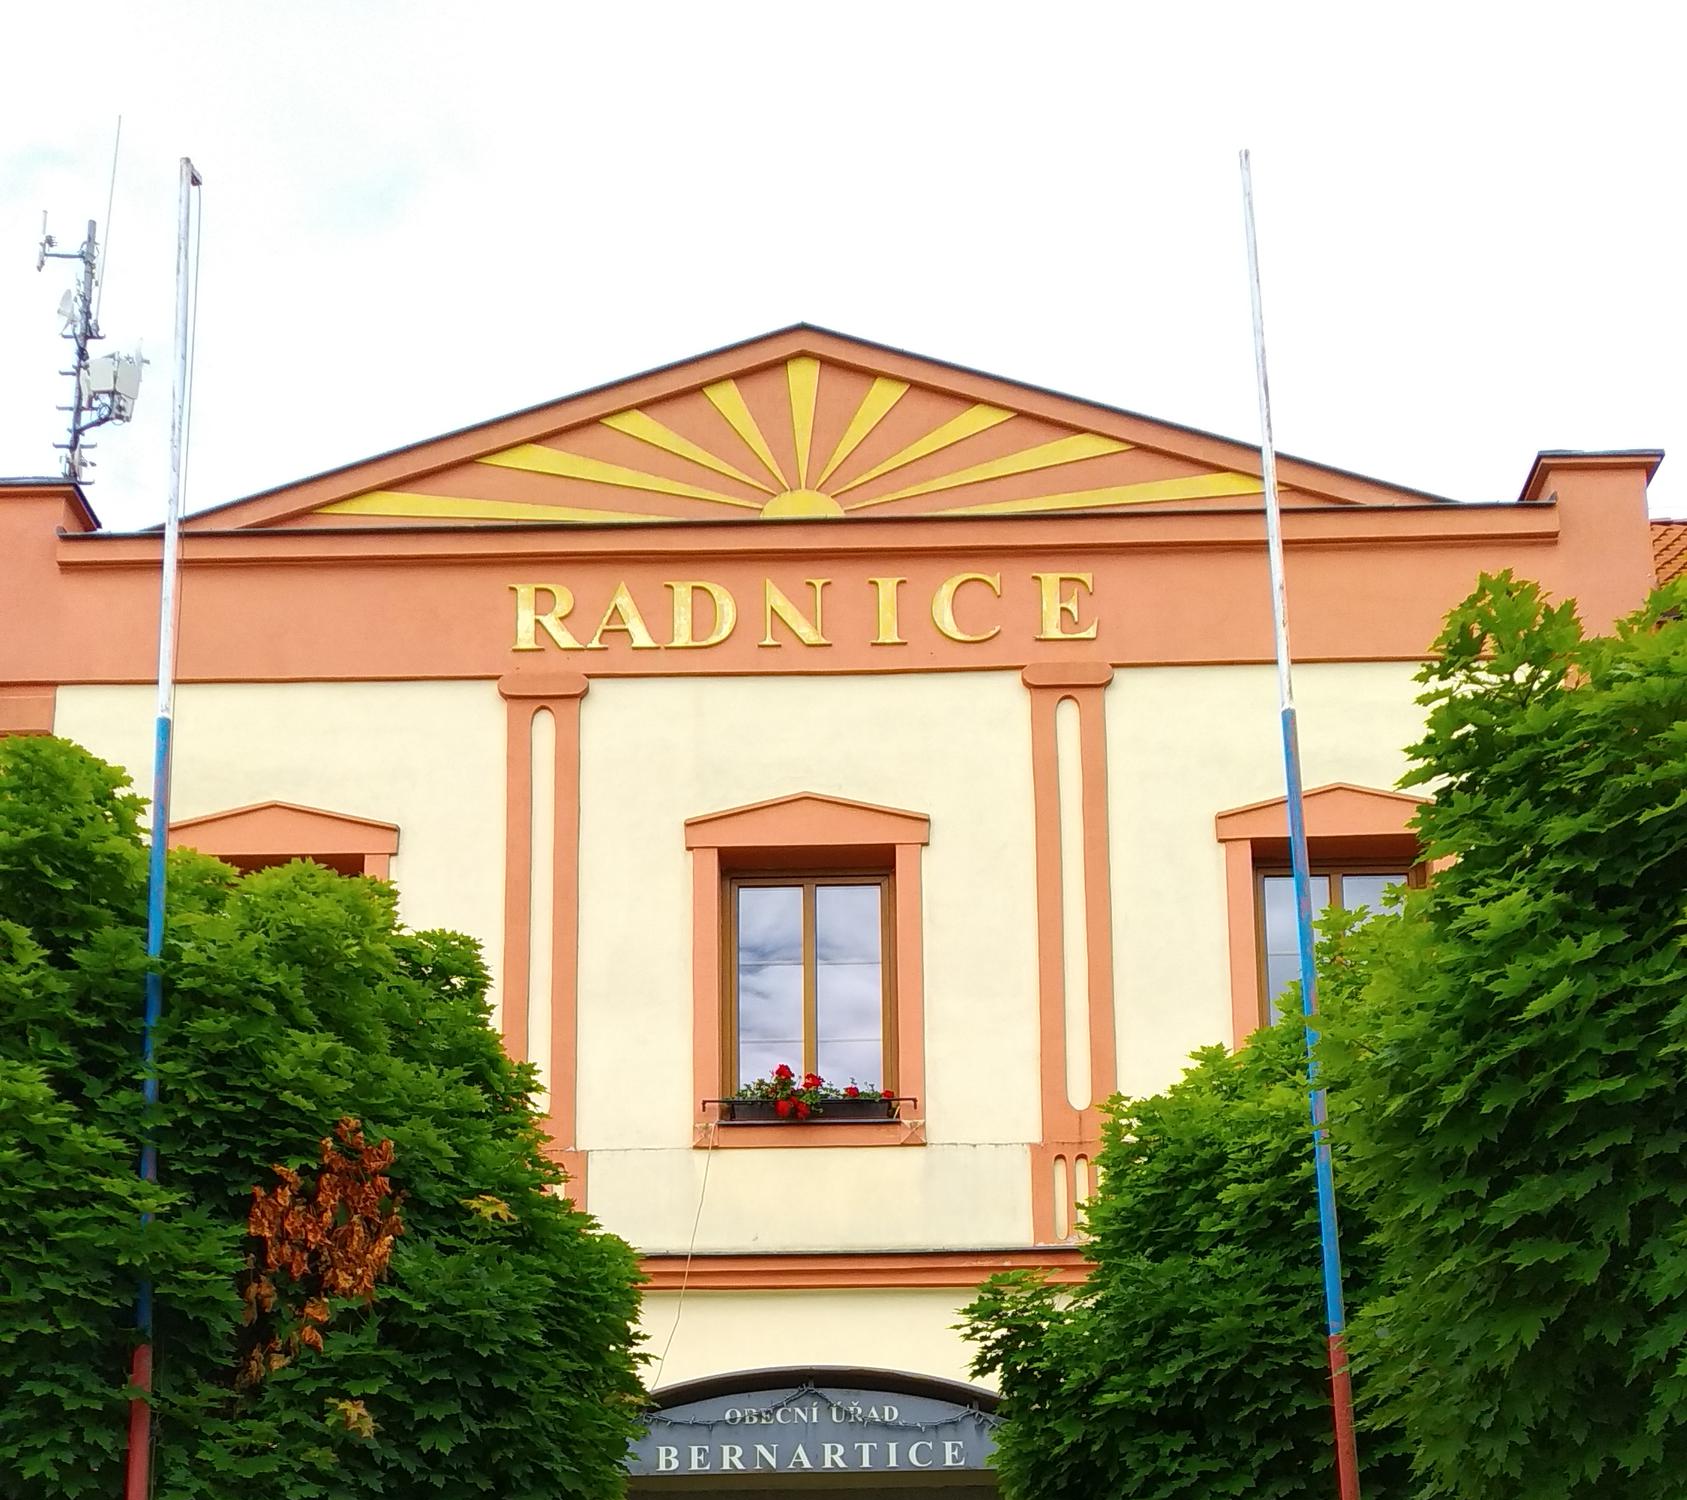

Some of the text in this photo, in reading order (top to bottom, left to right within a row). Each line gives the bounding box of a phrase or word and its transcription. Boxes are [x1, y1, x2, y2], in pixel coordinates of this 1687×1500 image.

[508, 571, 1100, 652] RADNICE
[724, 1400, 899, 1425] OBECNÍ ÚŘAD
[655, 1440, 966, 1472] BERNARTICE
